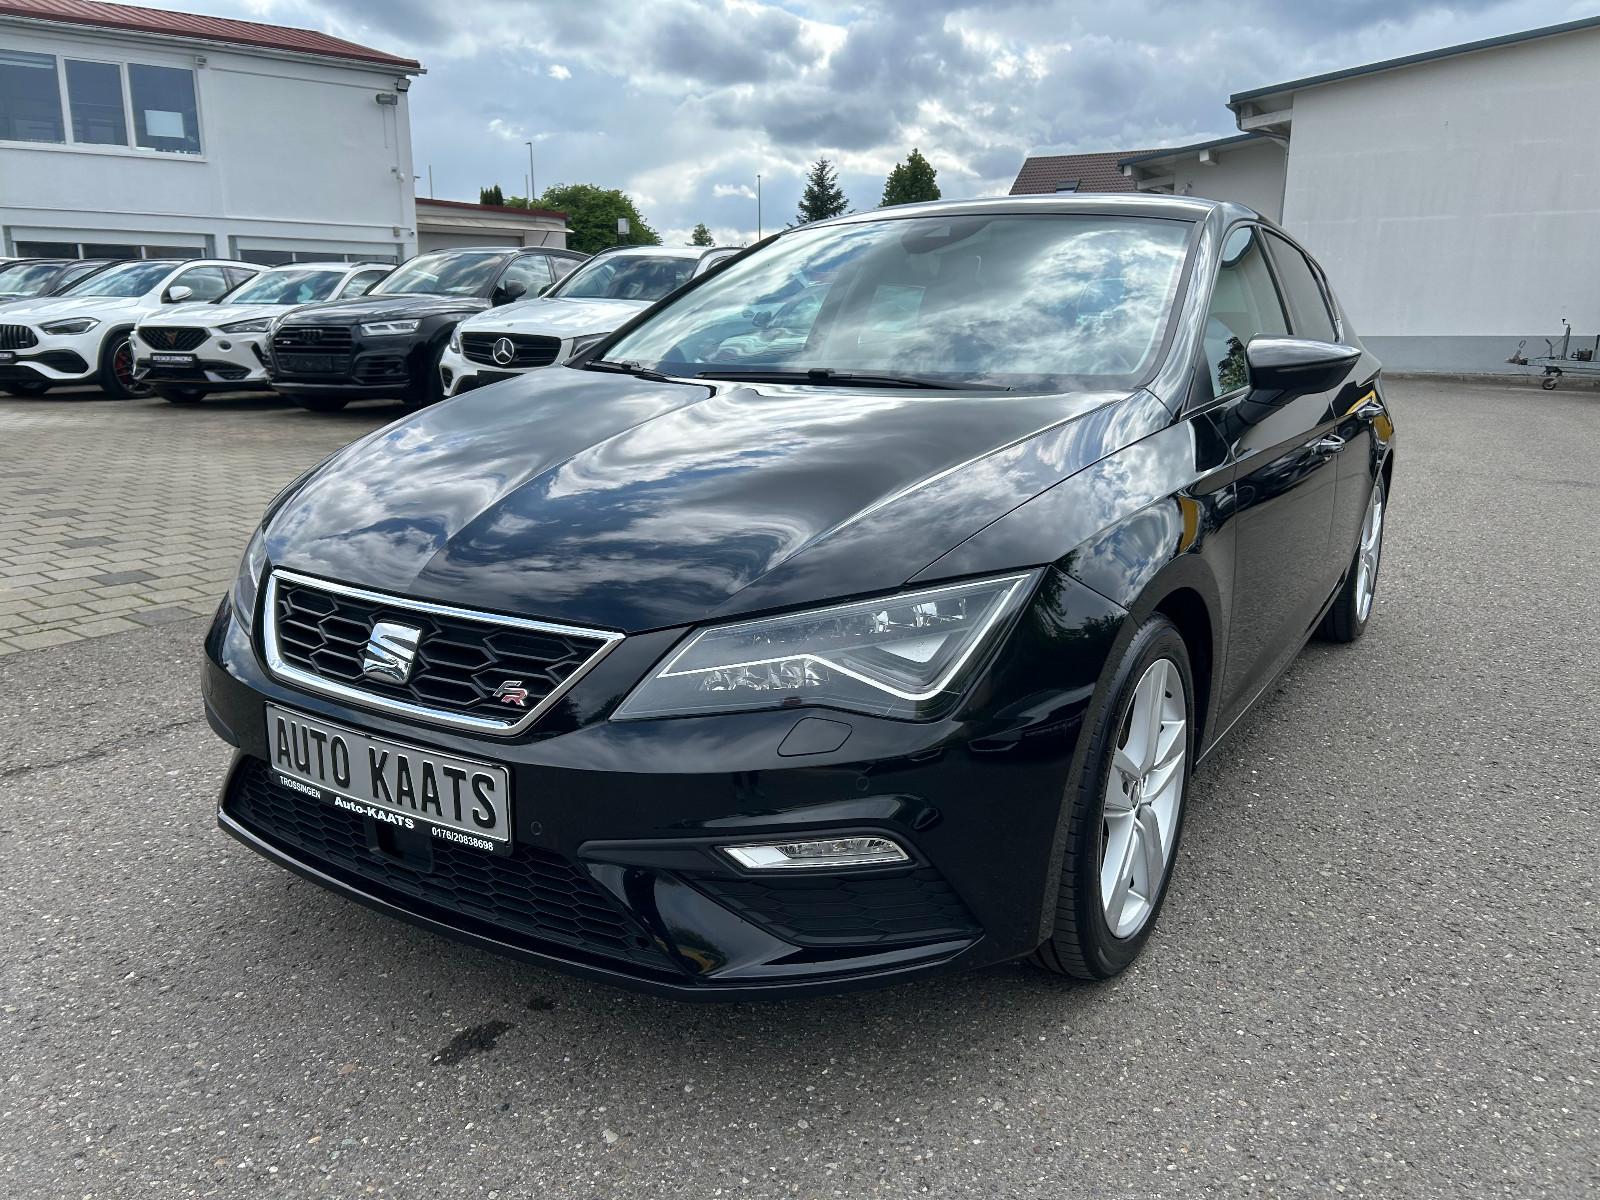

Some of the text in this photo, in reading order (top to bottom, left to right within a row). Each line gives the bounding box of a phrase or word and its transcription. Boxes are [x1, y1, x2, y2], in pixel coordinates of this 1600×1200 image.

[277, 716, 497, 829] AUTO KAATS
[279, 775, 321, 800] TROSSINGEN
[334, 796, 415, 829] Auto-KAATS
[431, 826, 494, 851] 0176/20838698
